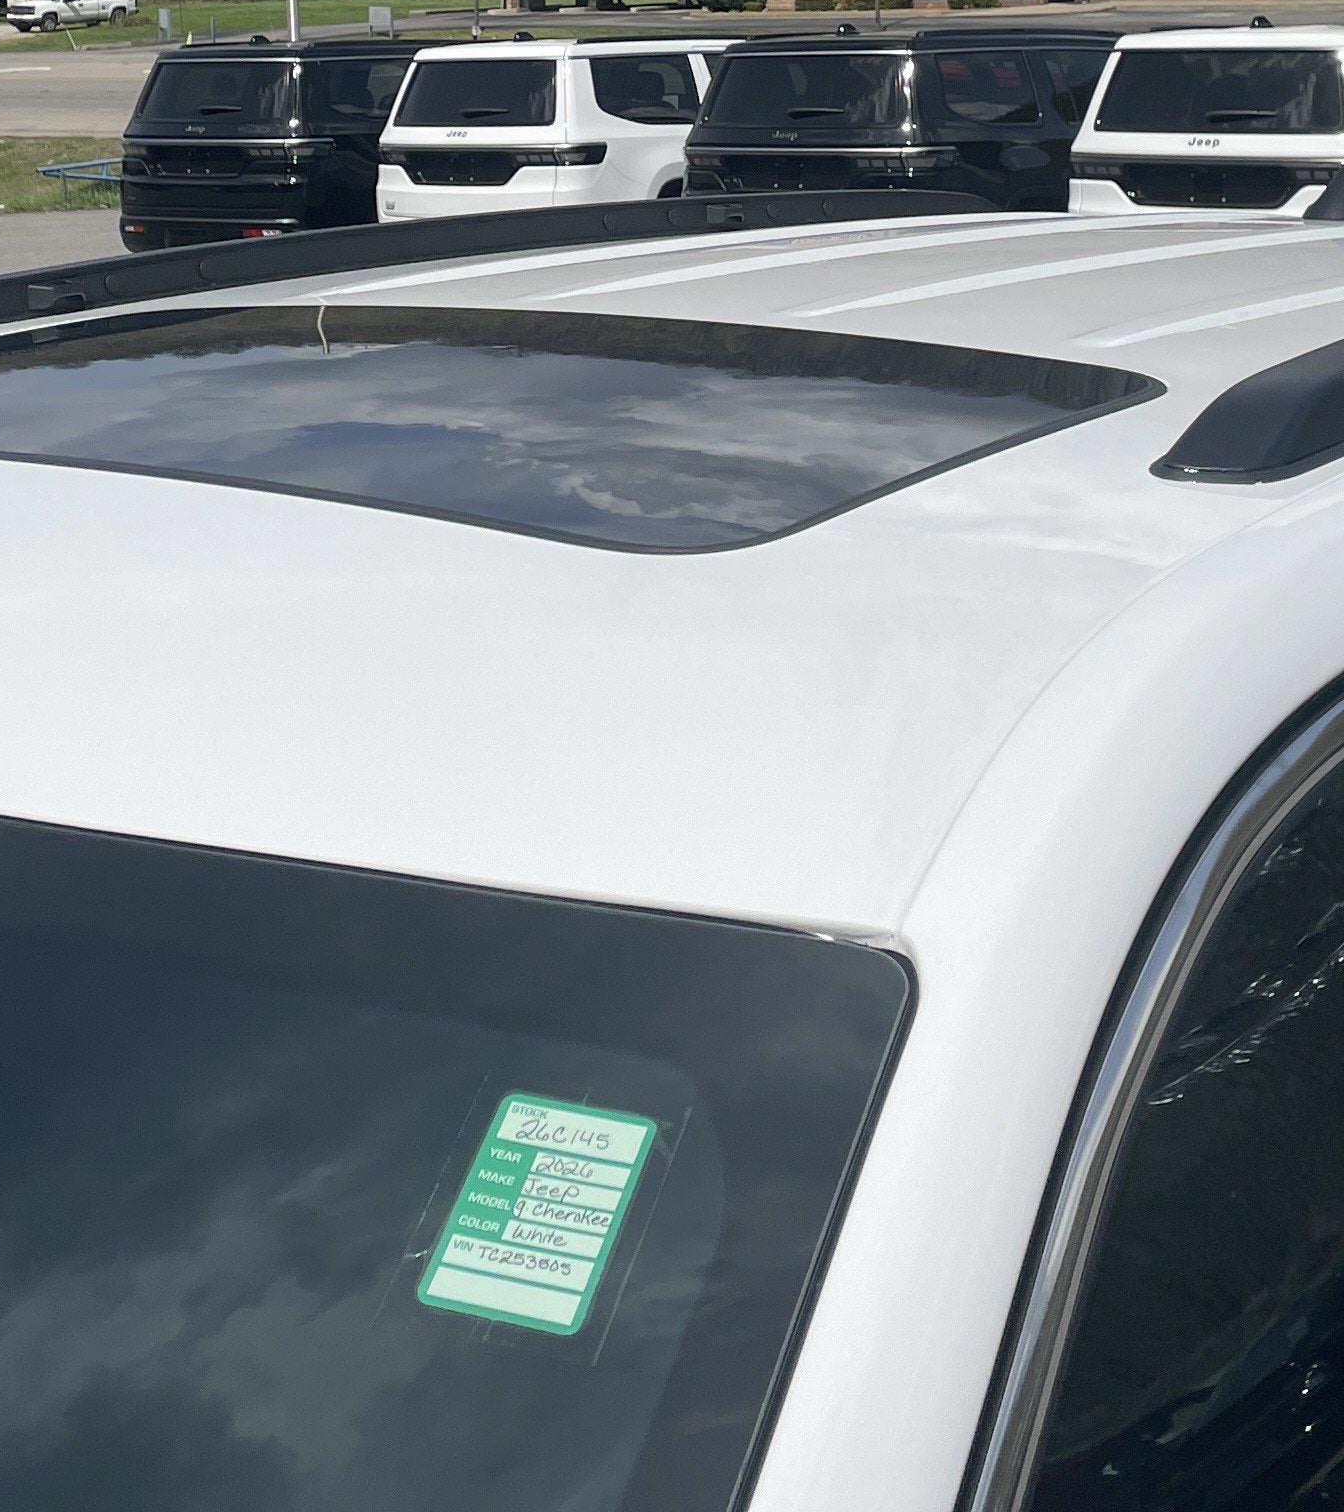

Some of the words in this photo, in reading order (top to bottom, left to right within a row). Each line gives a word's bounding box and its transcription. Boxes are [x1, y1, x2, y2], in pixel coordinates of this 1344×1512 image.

[1188, 137, 1220, 148] Jeep
[510, 1104, 551, 1119] STOCK
[489, 1147, 522, 1164] YEAR
[536, 1156, 594, 1179] 2026
[478, 1169, 516, 1187] MAKE
[525, 1177, 580, 1203] Jeep
[468, 1192, 512, 1211] MODEL
[458, 1215, 501, 1233] COLOR
[453, 1239, 474, 1253] VIN
